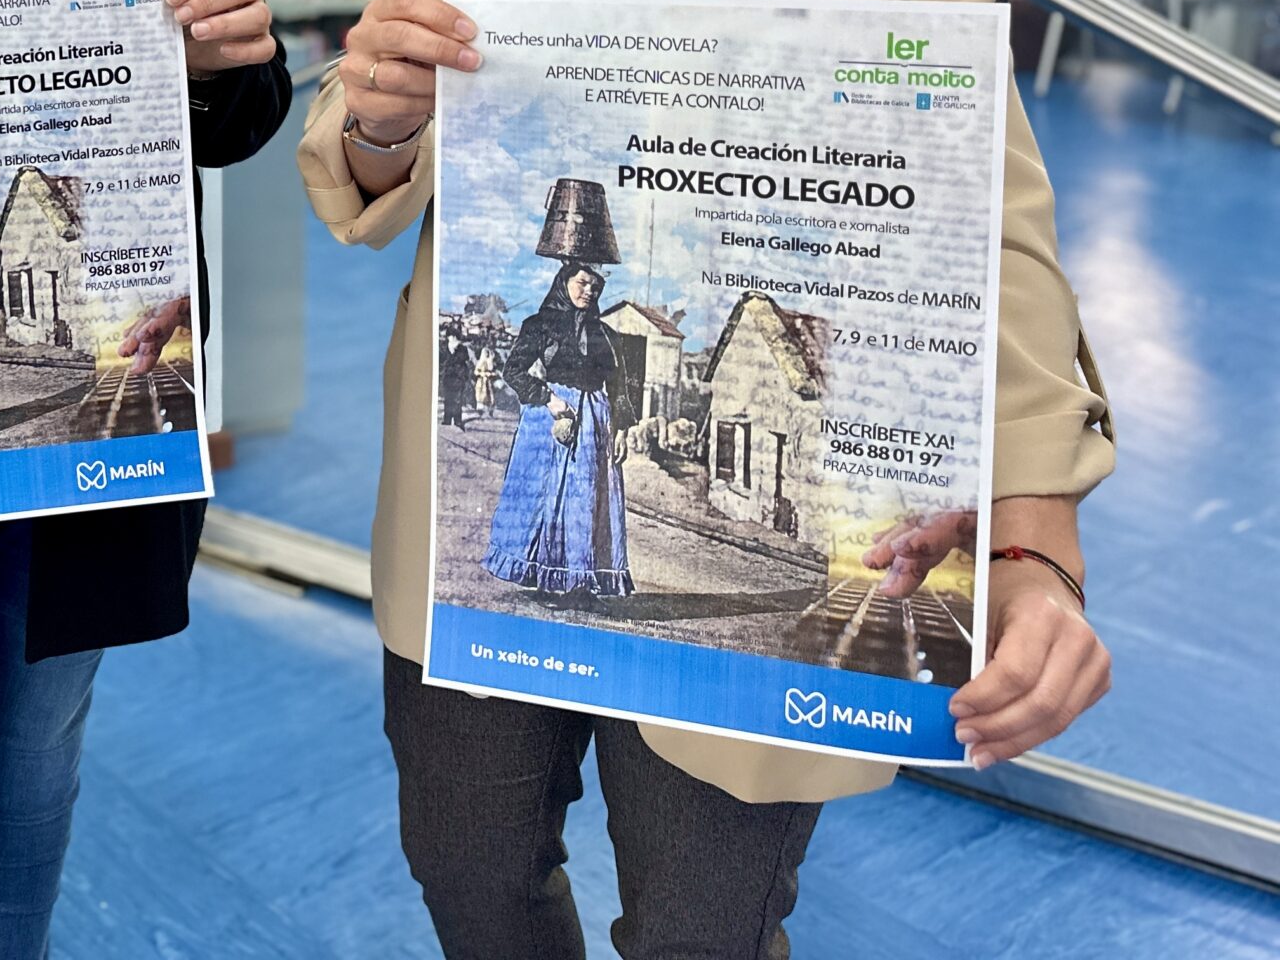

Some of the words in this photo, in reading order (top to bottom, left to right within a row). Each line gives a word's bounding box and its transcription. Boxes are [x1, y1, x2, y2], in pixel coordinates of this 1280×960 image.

[58, 43, 123, 60] Literaria
[485, 31, 544, 46] Tiveches
[546, 33, 583, 48] unha
[584, 34, 621, 49] VIDA
[624, 35, 645, 50] DE
[648, 36, 718, 53] NOVELA?
[886, 31, 929, 60] ler
[39, 65, 131, 92] LEGADO
[545, 65, 614, 82] APRENDE
[616, 66, 690, 85] TÉCNICAS
[693, 71, 714, 86] DE
[718, 73, 805, 91] NARRATIVA
[834, 67, 899, 85] conta
[907, 69, 975, 88] moito
[585, 88, 593, 102] E
[596, 88, 669, 106] ATRÉVETE
[671, 93, 683, 107] A
[685, 93, 764, 111] CONTALO!
[933, 101, 942, 109] DE
[32, 118, 79, 132] Gallego
[80, 113, 112, 127] Abad
[4, 153, 60, 166] Biblioteca
[61, 147, 89, 161] Vidal
[91, 147, 124, 158] Pazos
[125, 143, 139, 155] de
[141, 137, 180, 153] MARÍN
[626, 134, 674, 154] Aula
[678, 136, 707, 156] de
[710, 139, 807, 163] Creación
[812, 145, 906, 170] Literaria
[618, 164, 777, 199] PROXECTO
[783, 176, 915, 209] LEGADO
[695, 206, 753, 222] Impartida
[755, 212, 782, 226] pola
[784, 216, 836, 229] escritora
[838, 221, 847, 230] e
[849, 221, 910, 235] xornalista
[80, 246, 150, 263] INSCRÍBETE
[151, 244, 172, 258] XA!
[721, 231, 765, 248] Elena
[767, 235, 832, 257] Gallego
[834, 241, 880, 258] Abad
[88, 264, 112, 277] 986
[114, 263, 130, 275] 88
[131, 261, 146, 273] 01
[149, 260, 165, 272] 97
[701, 270, 721, 285] Na
[725, 273, 802, 294] Biblioteca
[803, 280, 844, 298] Vidal
[847, 284, 894, 303] Pazos
[897, 289, 918, 305] de
[921, 291, 980, 310] MARÍN
[866, 335, 877, 347] e
[881, 334, 898, 349] 11
[904, 335, 925, 351] de
[928, 337, 977, 357] MAIO
[820, 418, 921, 446] INSCRÍBETE
[924, 431, 955, 450] XA!
[830, 439, 864, 457] 986
[866, 444, 890, 460] 88
[892, 447, 913, 464] 01
[919, 451, 943, 467] 97
[109, 459, 164, 480] MARÍN
[823, 458, 874, 477] PRAZAS
[876, 466, 949, 488] LIMITADAS!
[471, 643, 493, 659] Un
[497, 650, 539, 667] xeito
[543, 656, 564, 671] de
[568, 662, 599, 677] ser.
[832, 704, 912, 734] MARÍN
